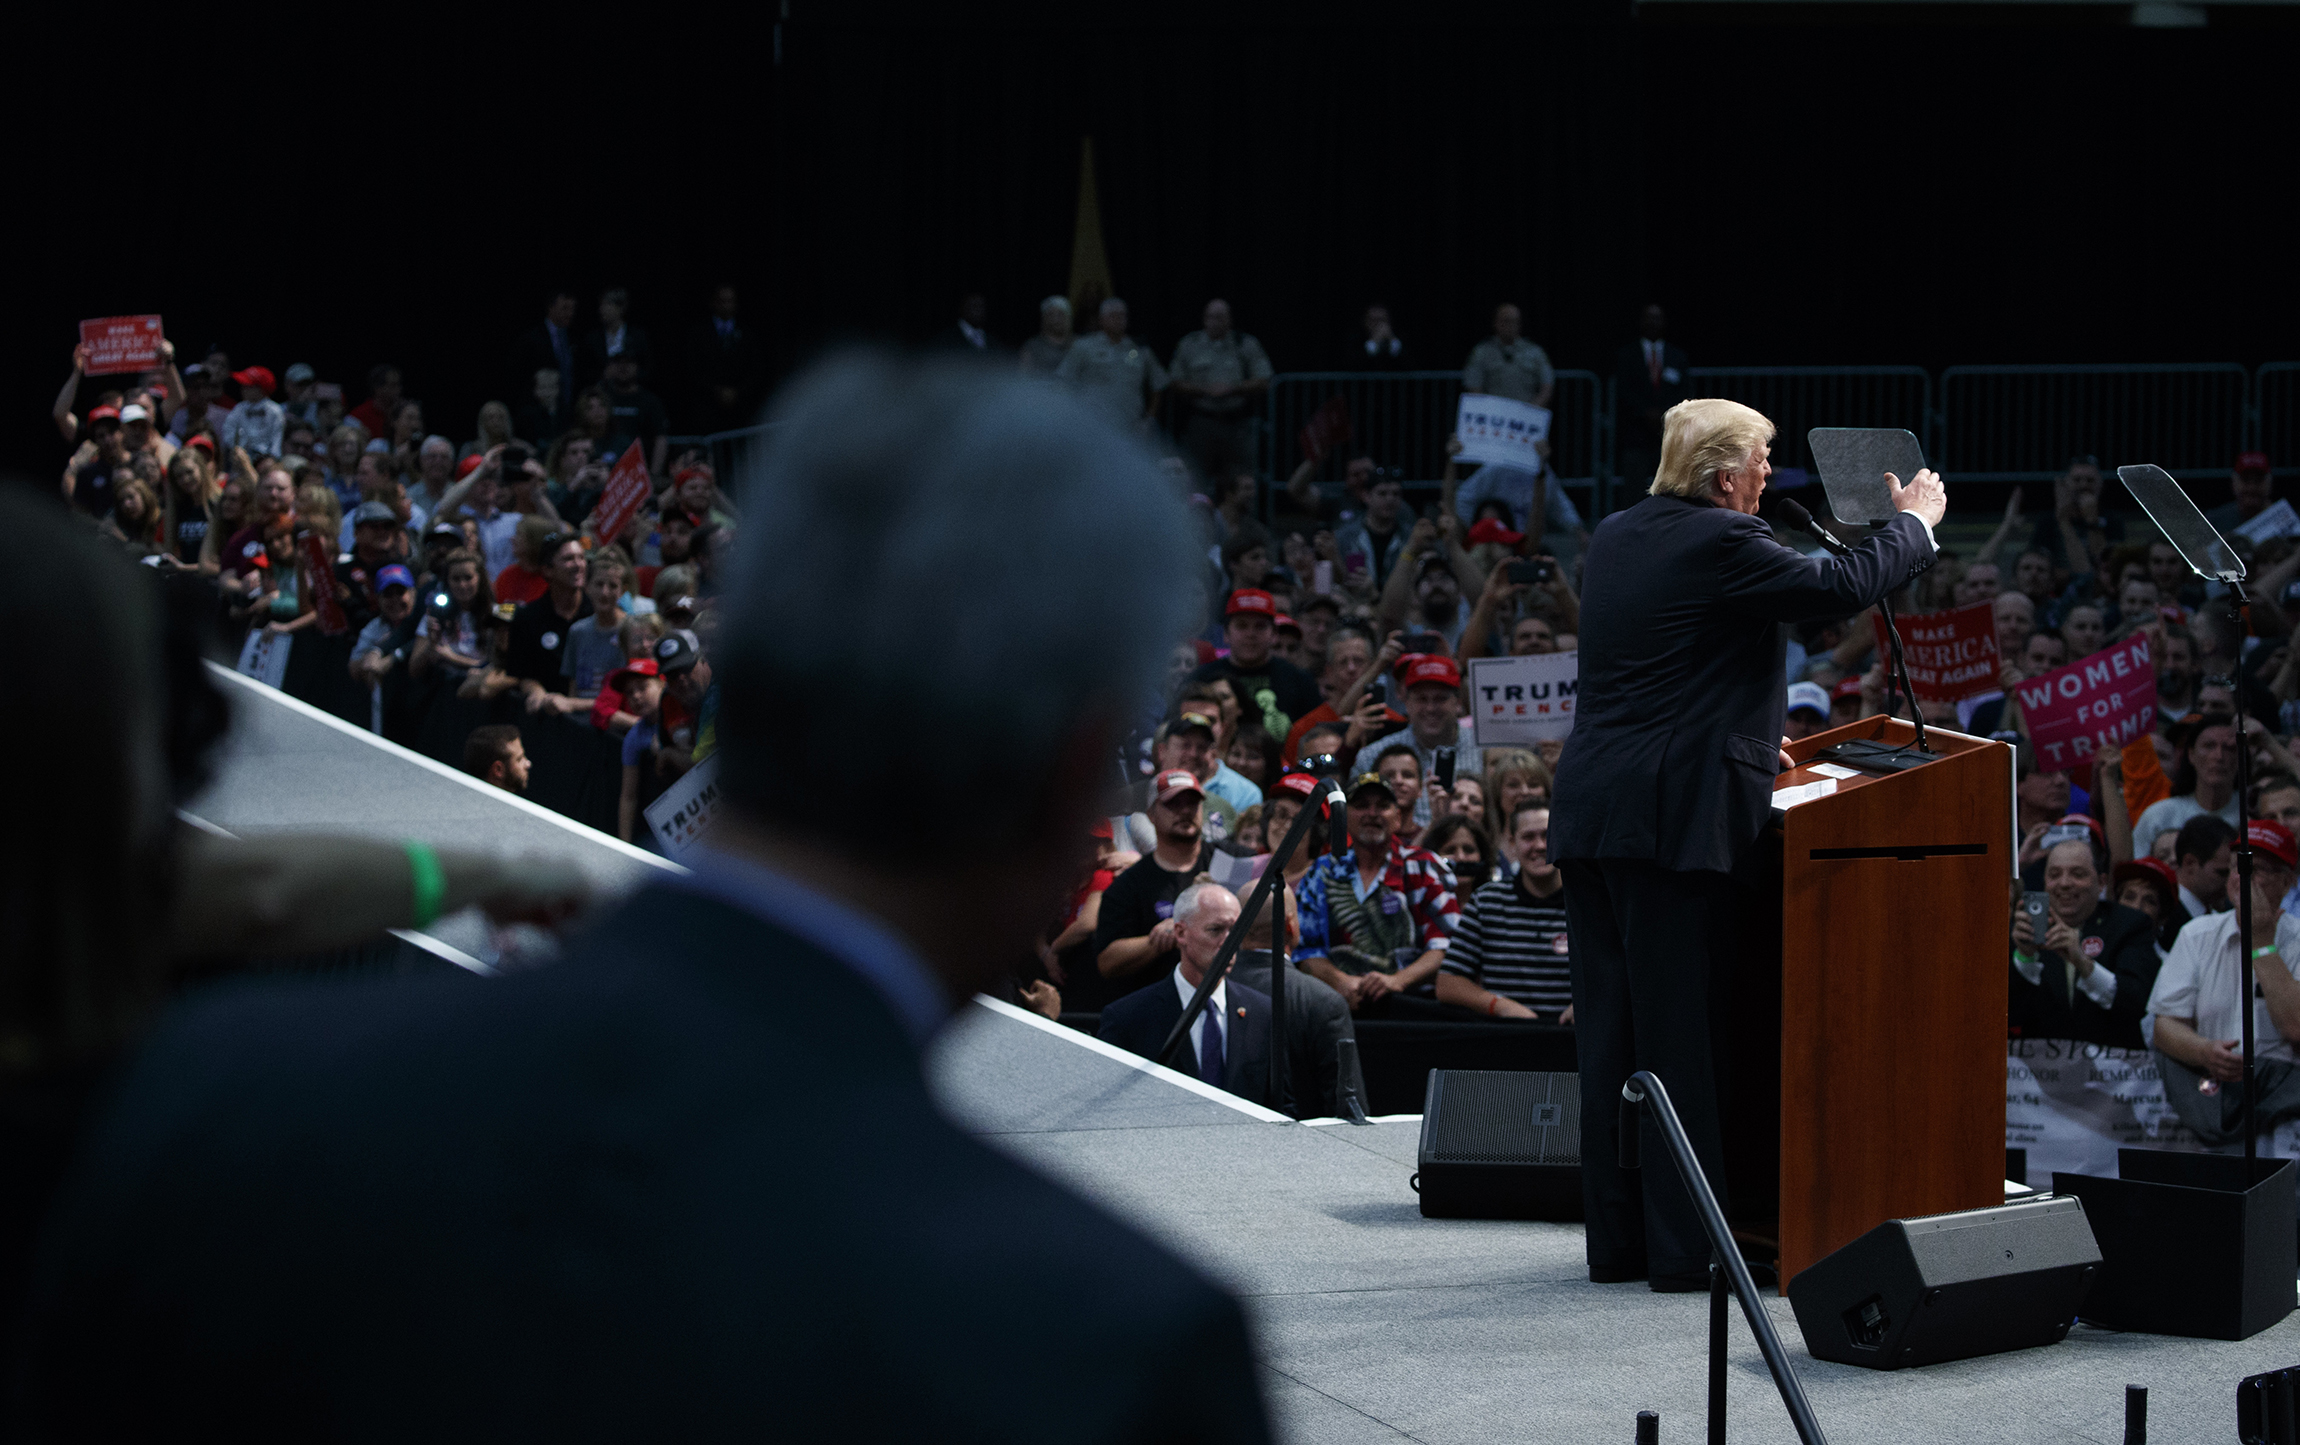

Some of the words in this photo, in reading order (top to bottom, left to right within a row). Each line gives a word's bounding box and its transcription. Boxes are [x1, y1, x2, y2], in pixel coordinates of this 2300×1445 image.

[1911, 623, 1956, 641] MAKE
[1940, 658, 1992, 687] AGAIN
[2020, 640, 2151, 711] WOMEN
[1481, 679, 1578, 701] TRUM
[1492, 699, 1572, 716] PENC
[2076, 692, 2125, 725] FOR
[2043, 704, 2154, 763] TRUMP
[661, 783, 718, 838] TRUM
[2088, 1068, 2161, 1083] REMEMB
